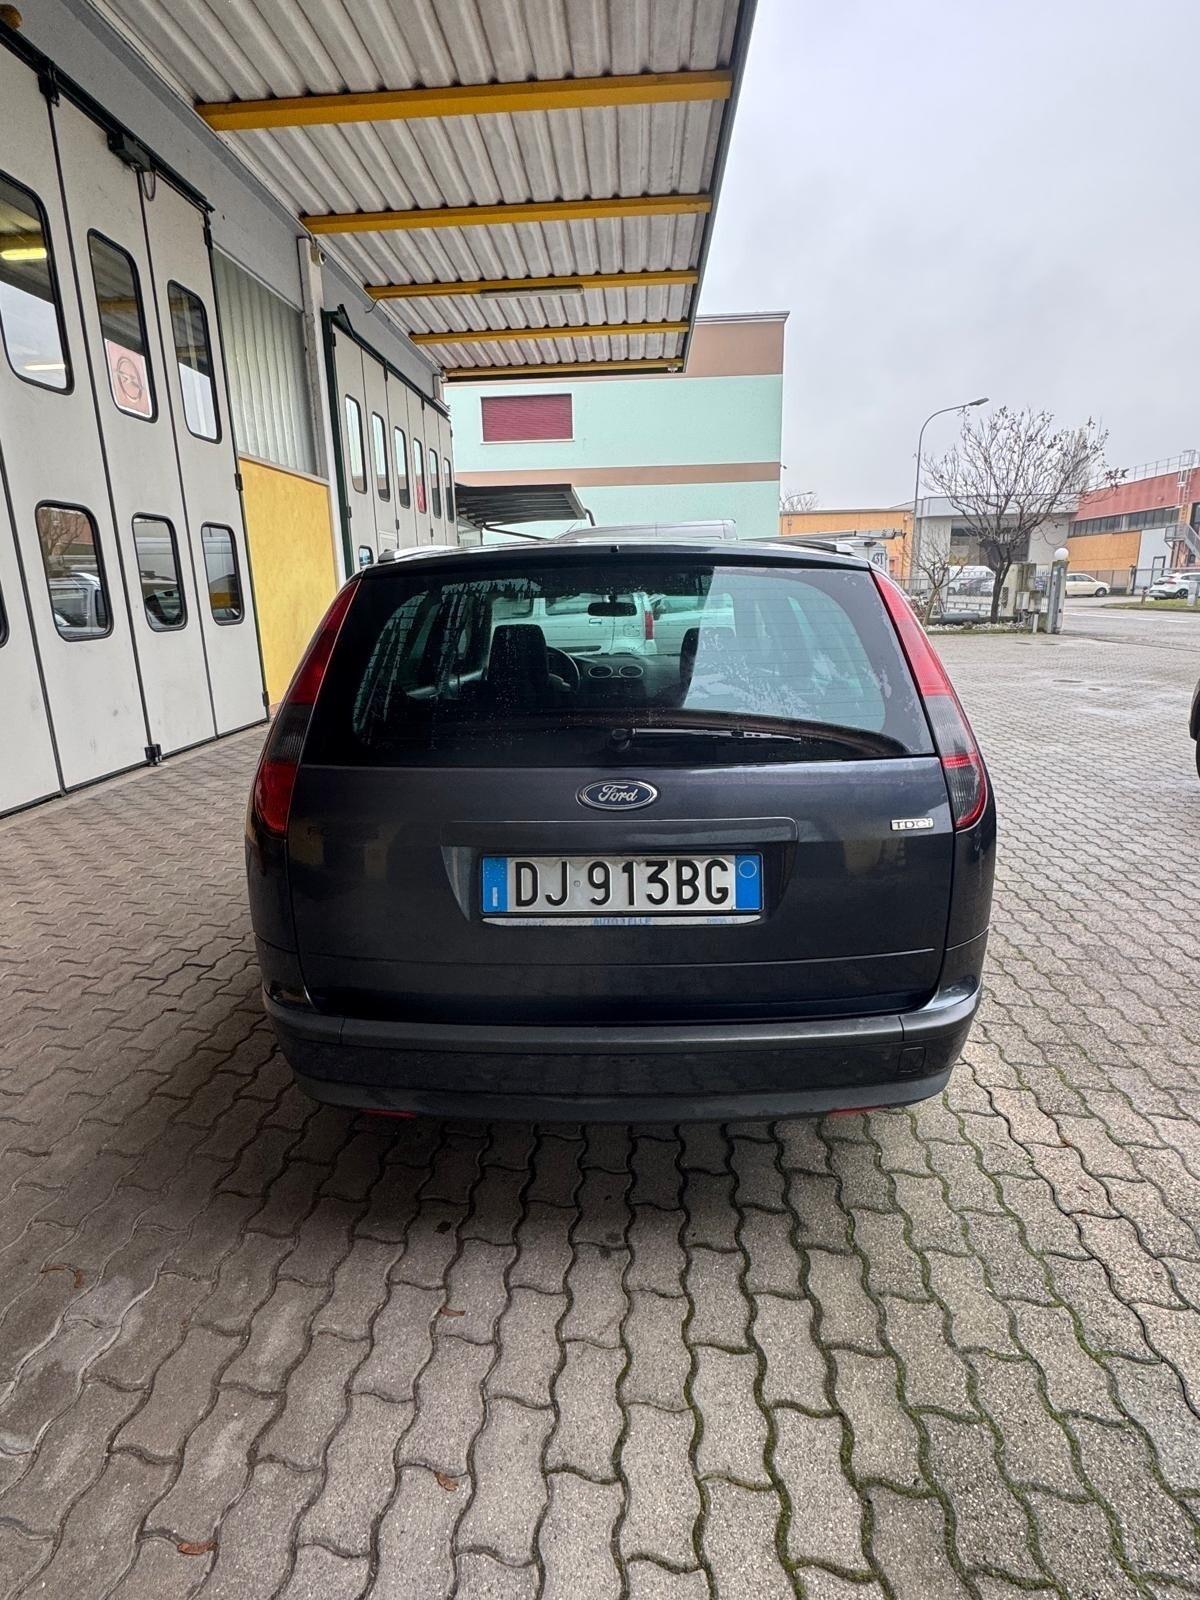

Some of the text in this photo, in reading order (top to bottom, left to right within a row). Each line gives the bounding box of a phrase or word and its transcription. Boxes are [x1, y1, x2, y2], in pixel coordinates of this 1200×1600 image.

[598, 784, 639, 802] Ford
[515, 859, 729, 907] DJ 913BG
